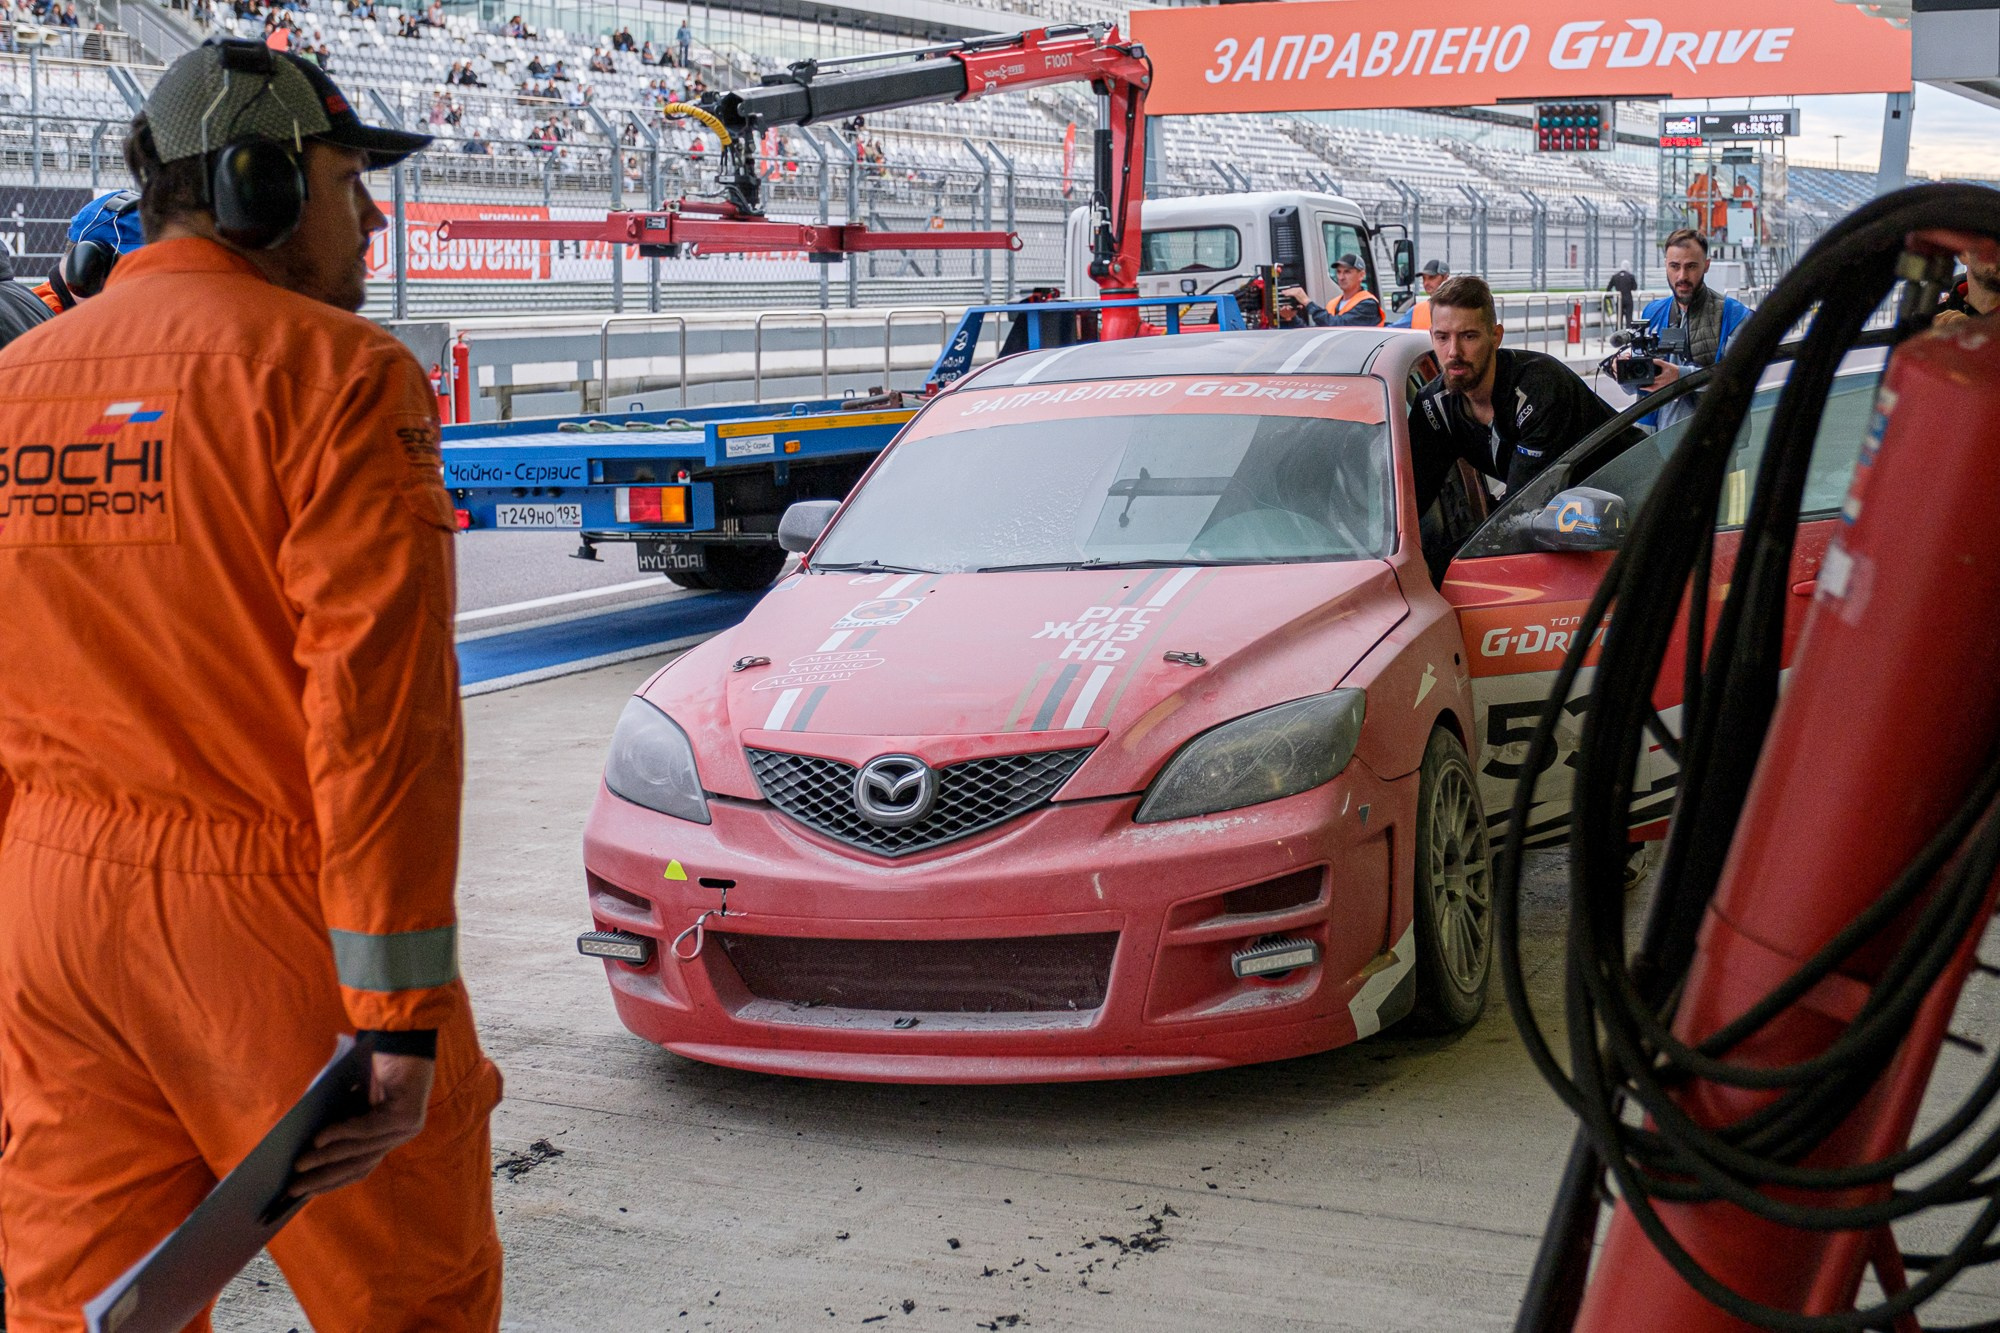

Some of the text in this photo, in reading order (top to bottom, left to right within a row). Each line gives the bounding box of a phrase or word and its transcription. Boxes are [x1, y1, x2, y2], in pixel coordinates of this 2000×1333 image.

[1044, 52, 1073, 69] F100T
[1205, 24, 1530, 83] ЗАПРАВЛЕНО
[960, 381, 1177, 416] ЗАПРАВЛЕНО
[556, 505, 578, 520] 193
[1076, 607, 1161, 624] РГС
[1030, 622, 1146, 641] ЖИЗ
[1480, 624, 1609, 657] G-DRIV
[806, 653, 870, 663] MAZDA
[1058, 640, 1126, 662] НЬ
[787, 662, 865, 674] KARTING
[767, 671, 856, 687] ACADEMY
[1482, 694, 1592, 780] 5
